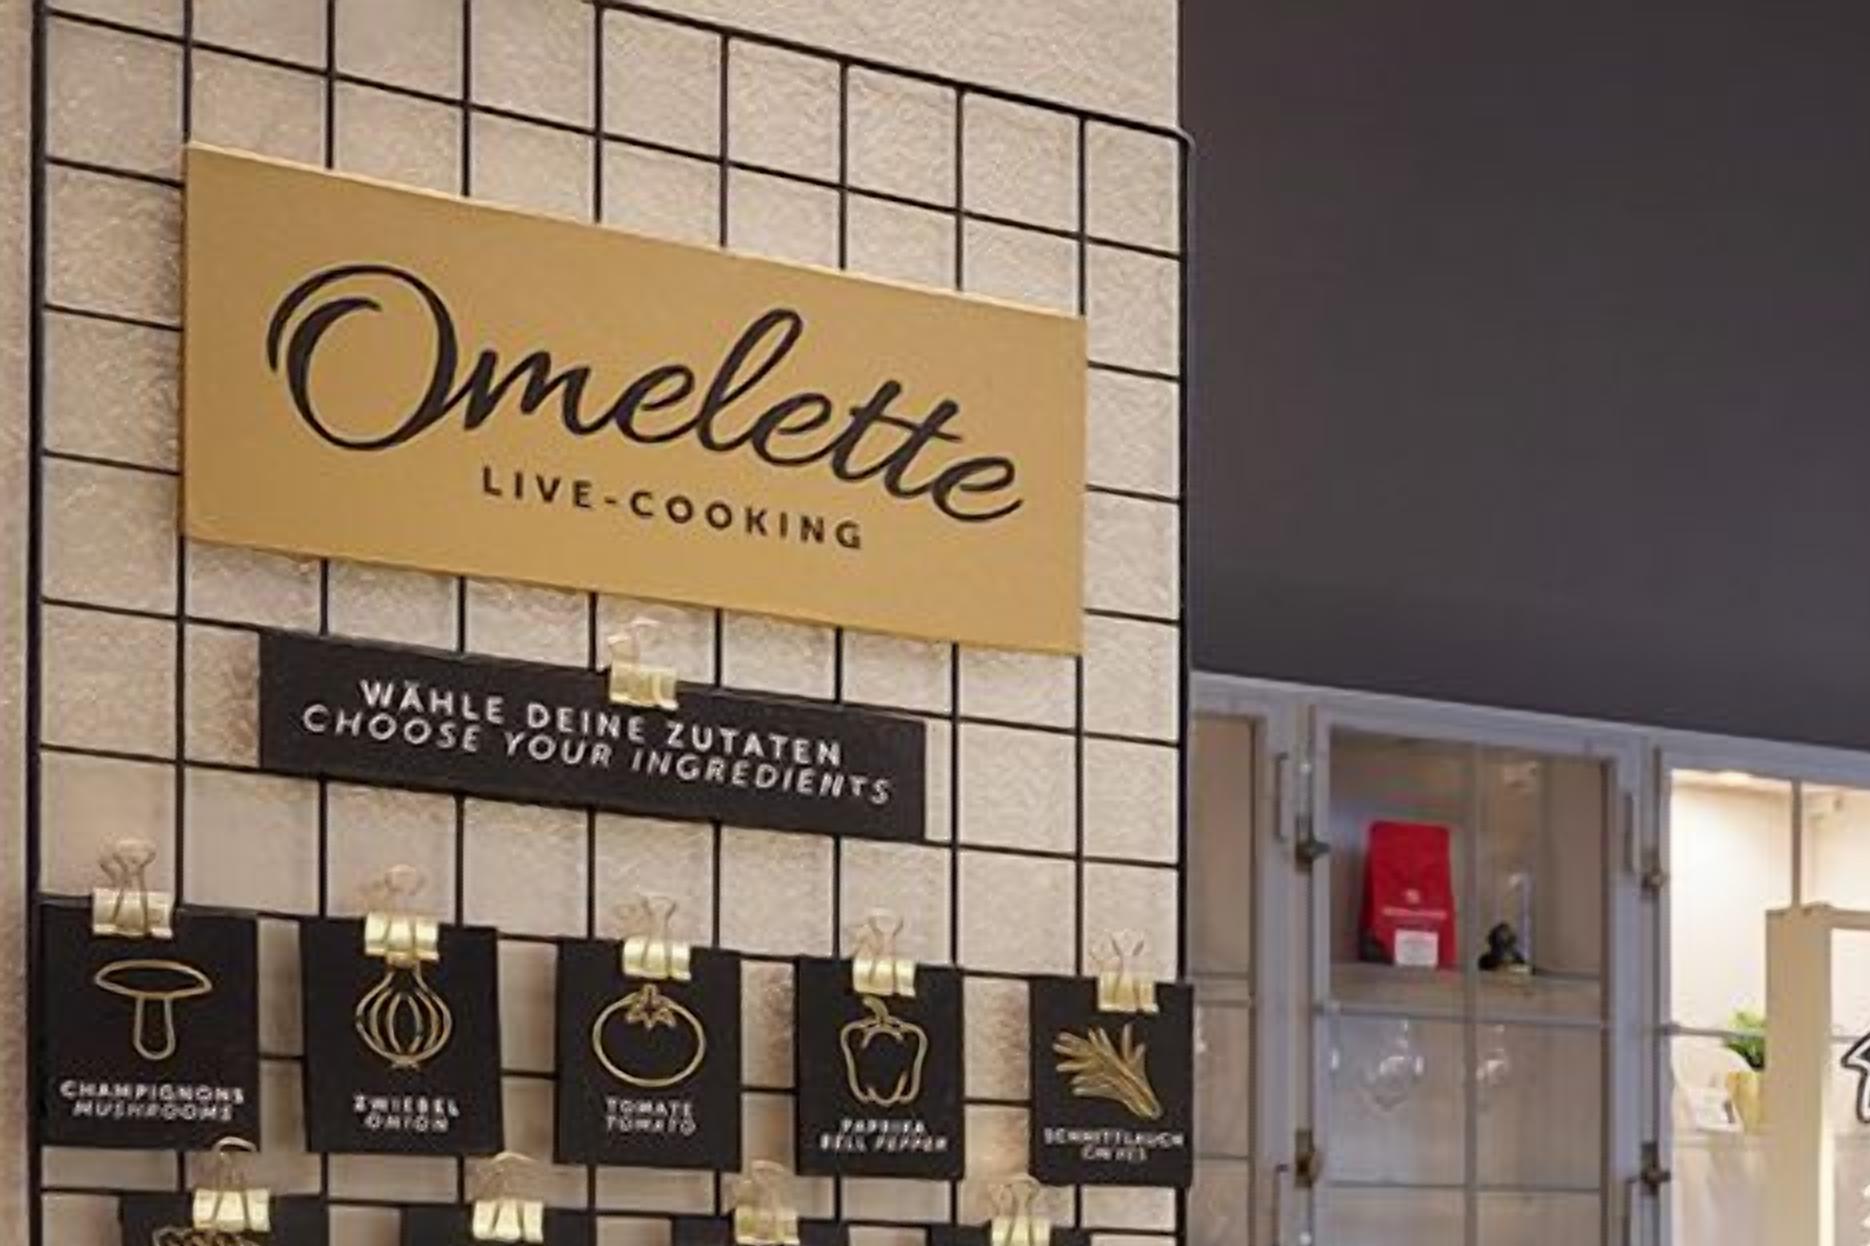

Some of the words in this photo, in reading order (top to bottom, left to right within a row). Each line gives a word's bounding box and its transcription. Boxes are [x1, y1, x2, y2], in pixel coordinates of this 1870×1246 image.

[266, 263, 1023, 522] Omelette
[481, 465, 863, 549] LIVE-COOKING
[300, 703, 479, 754] CHOOSE
[503, 730, 612, 770] YOUR
[631, 750, 893, 805] INGREDIENTS
[359, 678, 504, 725] WÄHLE
[526, 702, 644, 744] DEINE
[665, 721, 843, 767] ZUTATEN
[59, 1079, 245, 1104] CHAMPIGNONS
[73, 1100, 233, 1121] MUSHROOMS
